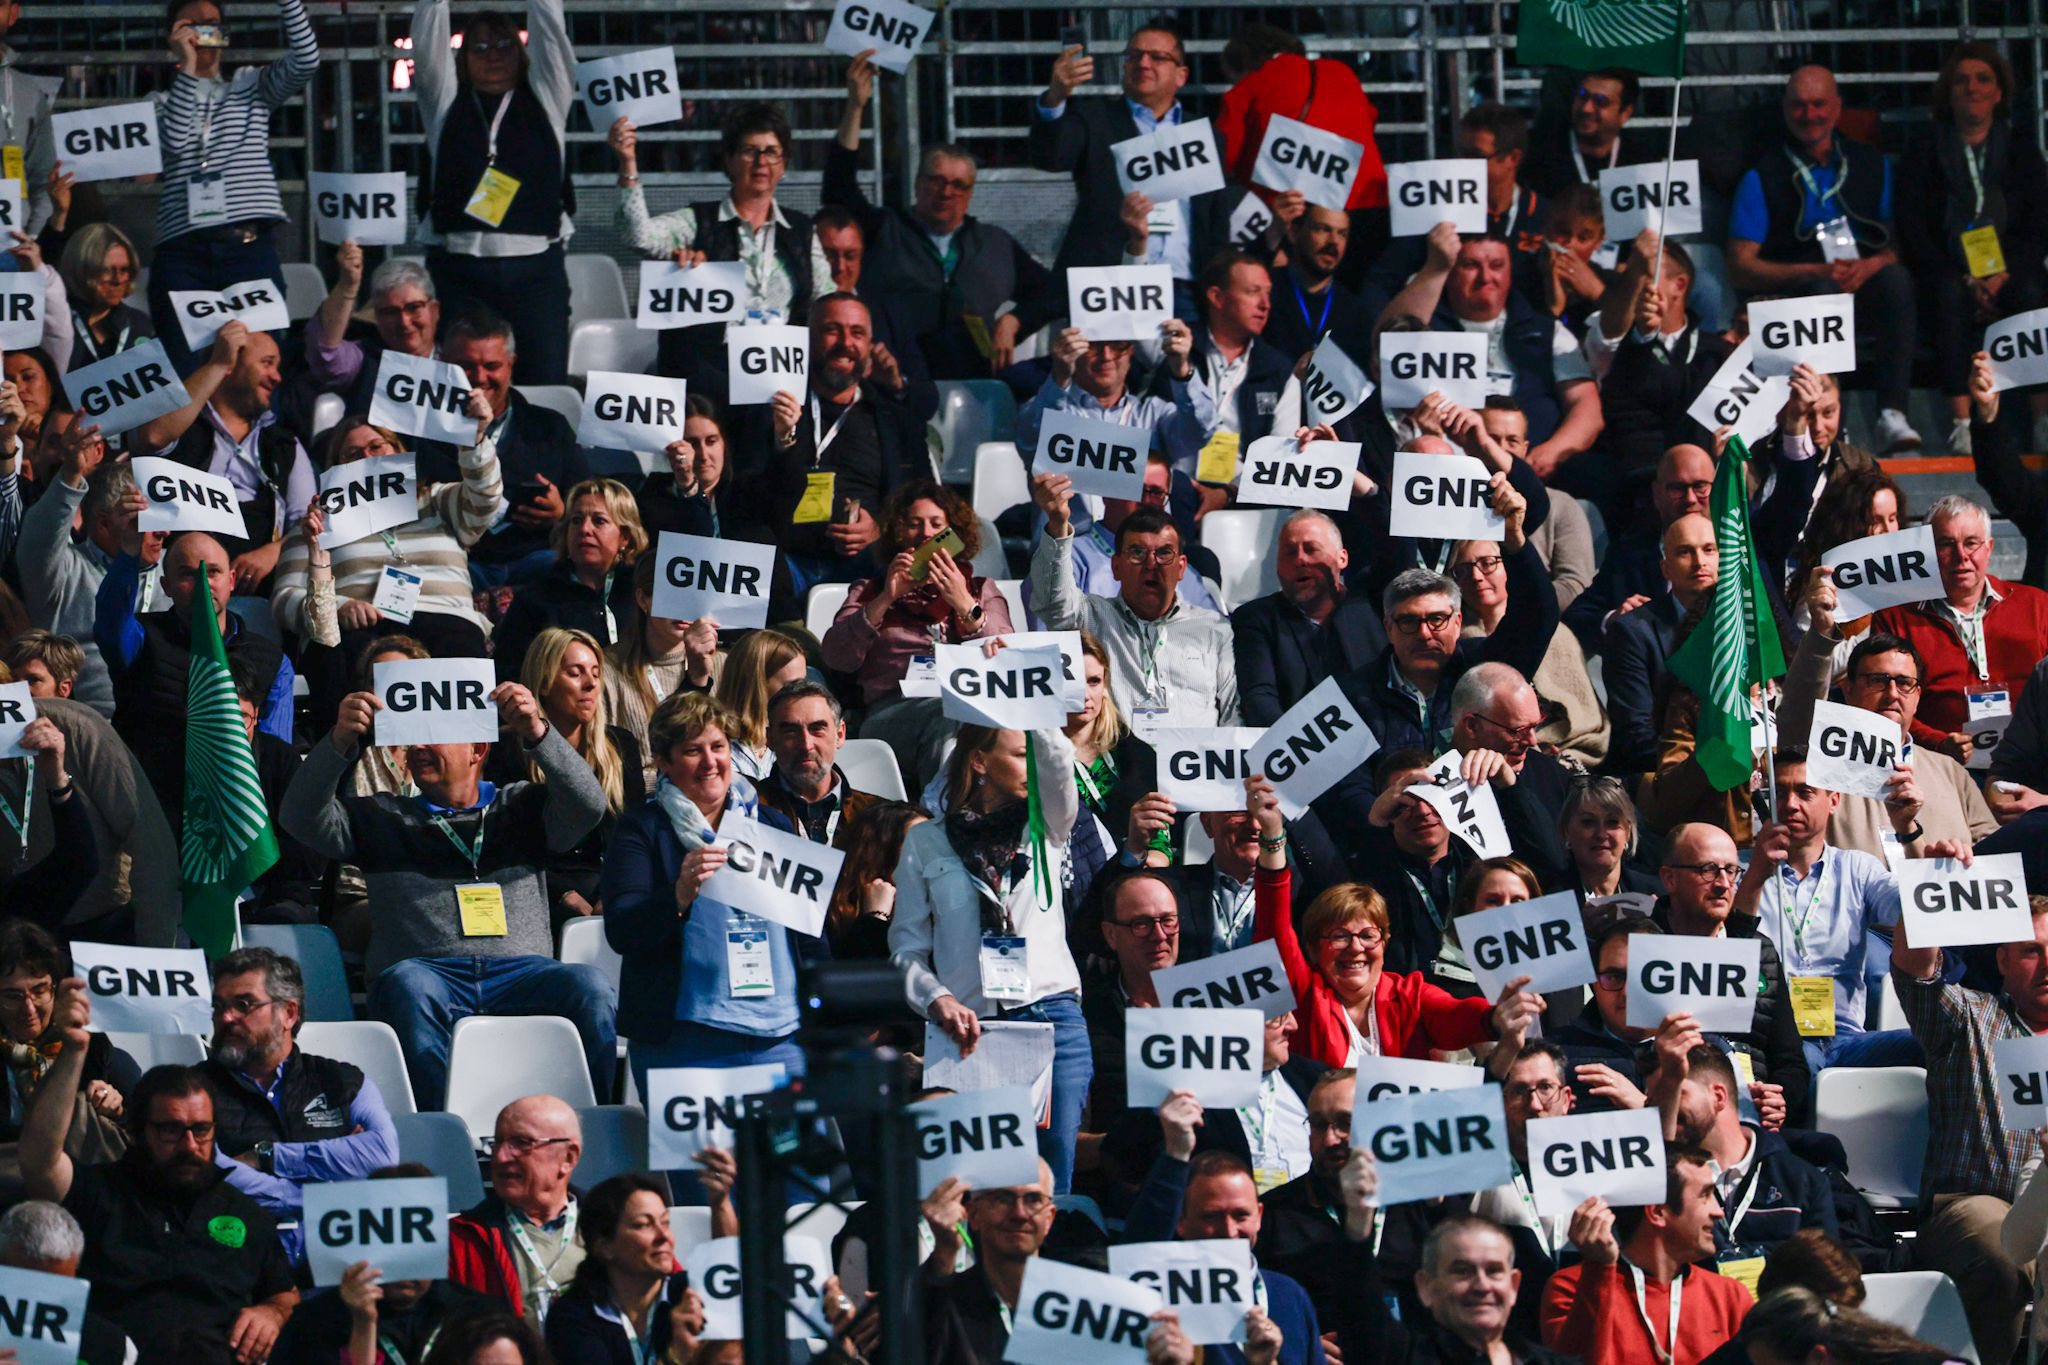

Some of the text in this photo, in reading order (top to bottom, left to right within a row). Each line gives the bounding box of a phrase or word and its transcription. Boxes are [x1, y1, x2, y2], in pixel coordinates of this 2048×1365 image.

[844, 5, 919, 48] GNR
[587, 69, 670, 106] GNR
[65, 122, 150, 155] GNR
[1126, 140, 1210, 182] GNR
[1271, 137, 1349, 184] GNR
[318, 193, 396, 220] GNR
[1400, 180, 1478, 207] GNR
[1610, 181, 1690, 213] GNR
[187, 289, 273, 317] GNR
[649, 288, 734, 313] GNR
[1080, 285, 1163, 312] GNR
[1762, 316, 1844, 350] GNR
[1990, 328, 2048, 362] GN
[740, 346, 804, 375] GNR
[1391, 352, 1476, 379] GNR
[80, 362, 171, 416] GNR
[387, 374, 472, 416] GNR
[1715, 364, 1765, 420] GN
[594, 393, 678, 427] GNR
[1047, 433, 1137, 474] GNR
[320, 471, 407, 515] GNR
[1252, 461, 1343, 490] GNR
[1404, 475, 1494, 508] GNR
[147, 475, 234, 515] GNR
[665, 556, 760, 597] GNR
[1832, 550, 1930, 589] GNR
[386, 680, 487, 712] GNR
[949, 667, 1054, 699] GNR
[1264, 705, 1353, 783] GNR
[1820, 726, 1895, 769] GNR
[728, 840, 824, 903] GNR
[1914, 879, 2017, 913] GNR
[1474, 919, 1576, 970] GNR
[88, 965, 198, 997] GNR
[1641, 961, 1746, 997] GNR
[1141, 1034, 1250, 1071] GNR
[918, 1112, 1023, 1160] GNR
[1371, 1115, 1495, 1164] GNR
[1543, 1136, 1654, 1176] GNR
[319, 1207, 437, 1246] GNR
[704, 1265, 819, 1299] GR
[1032, 1291, 1150, 1348] GNR
